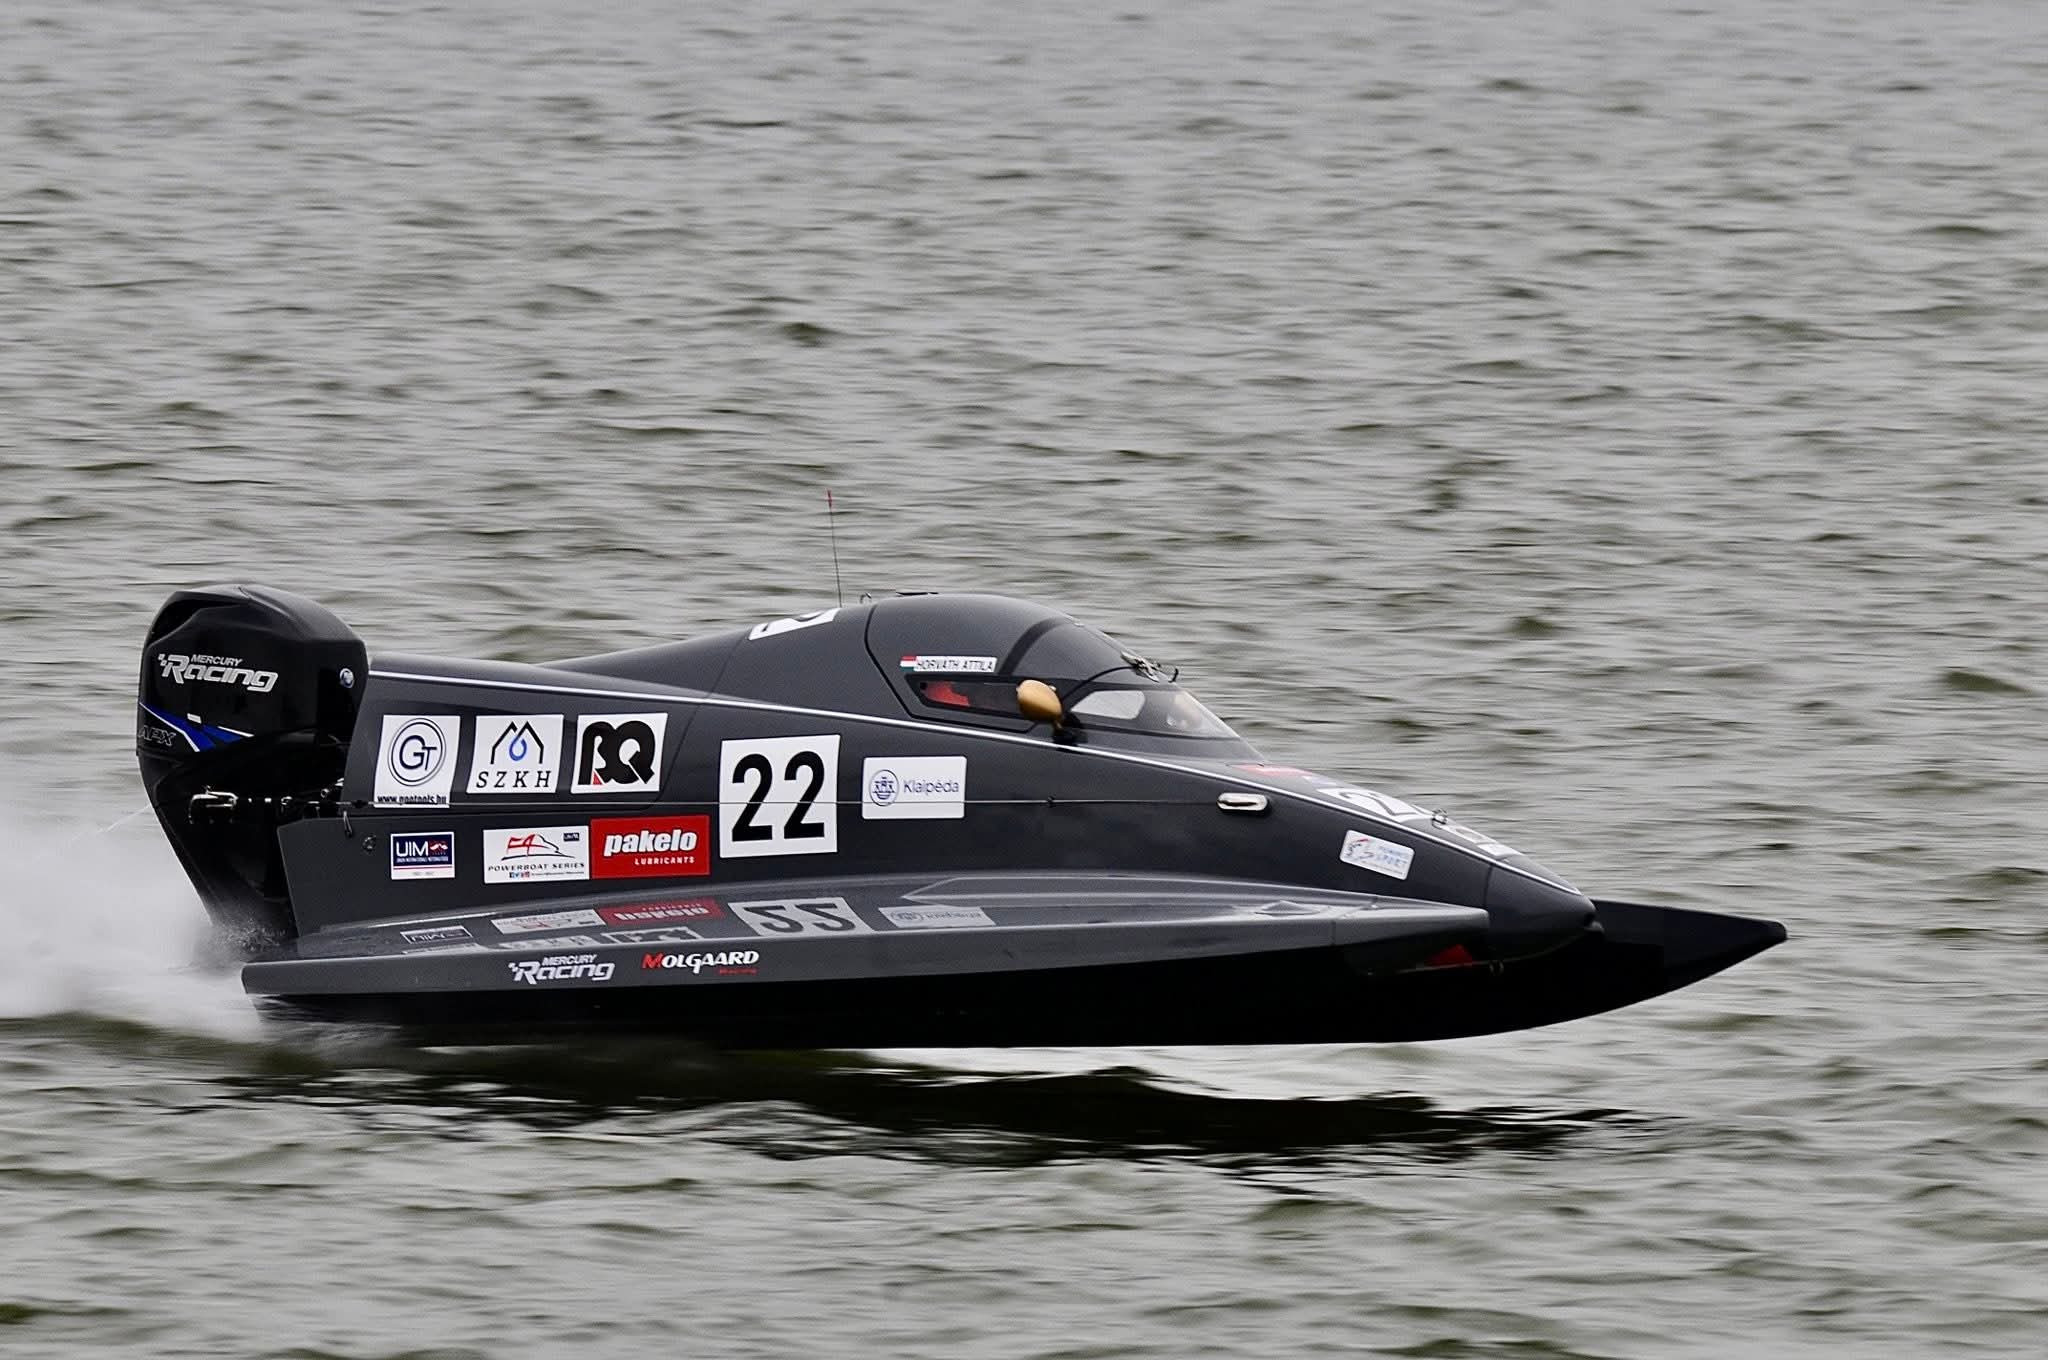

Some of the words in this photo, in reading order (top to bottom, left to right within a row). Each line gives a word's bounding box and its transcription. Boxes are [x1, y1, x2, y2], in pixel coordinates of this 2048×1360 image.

[190, 654, 243, 666] MERCURY
[161, 654, 279, 693] Racing
[399, 734, 438, 772] GT
[475, 770, 552, 789] SZKH
[903, 779, 960, 796] Klaipėda
[731, 750, 825, 842] 22
[395, 840, 429, 857] UIM
[603, 829, 698, 858] pakelo
[487, 863, 549, 872] POWERBOAT
[551, 862, 585, 870] SERIES
[633, 856, 695, 866] LUBRICANTS
[542, 953, 598, 965] MERCURY
[641, 950, 761, 974] MOLGAARD
[512, 961, 616, 985] Racing
